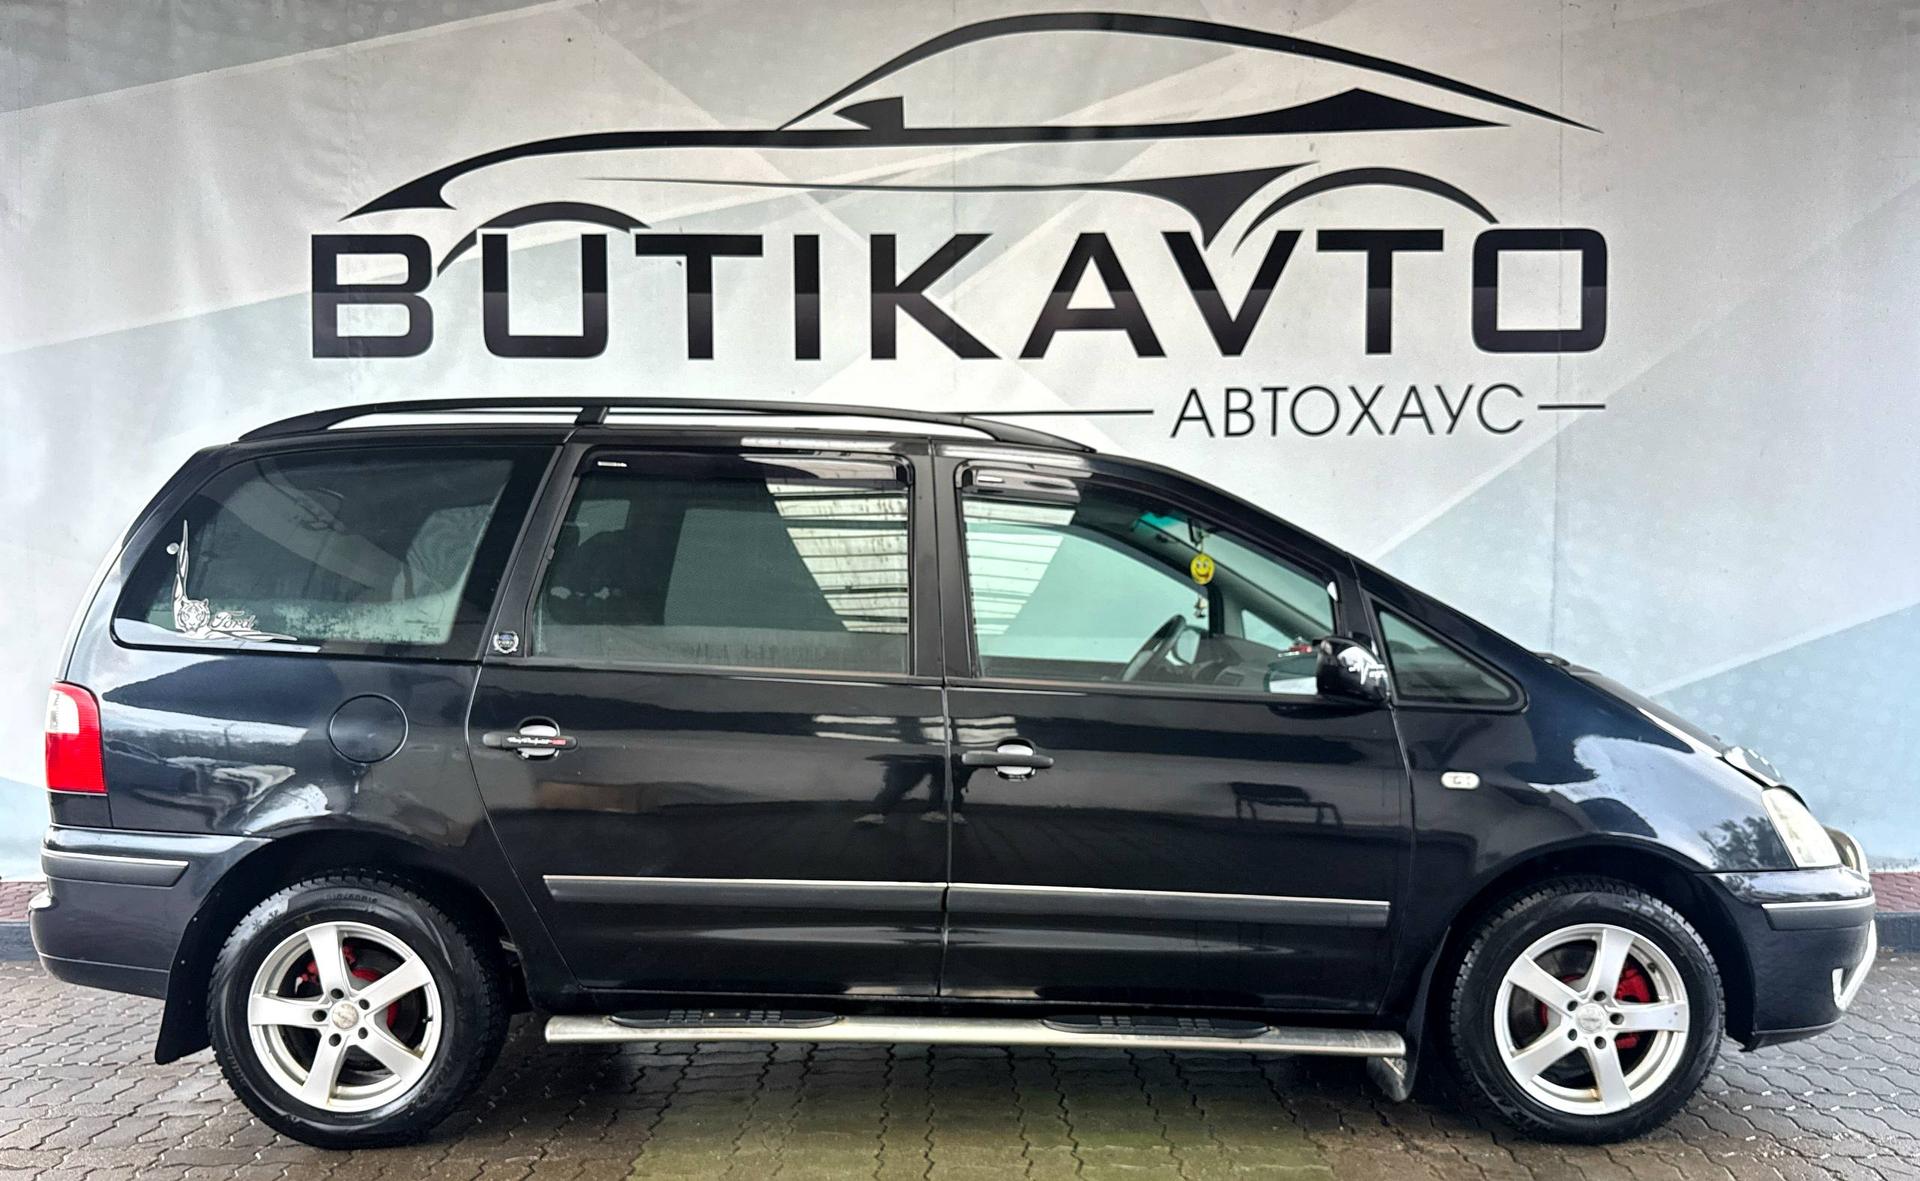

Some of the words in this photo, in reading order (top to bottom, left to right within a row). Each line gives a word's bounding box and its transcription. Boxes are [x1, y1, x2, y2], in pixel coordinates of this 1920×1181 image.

[311, 228, 1607, 359] BUTIKAVTO
[1170, 383, 1524, 438] АВТОХАУС
[210, 610, 256, 629] Ford
